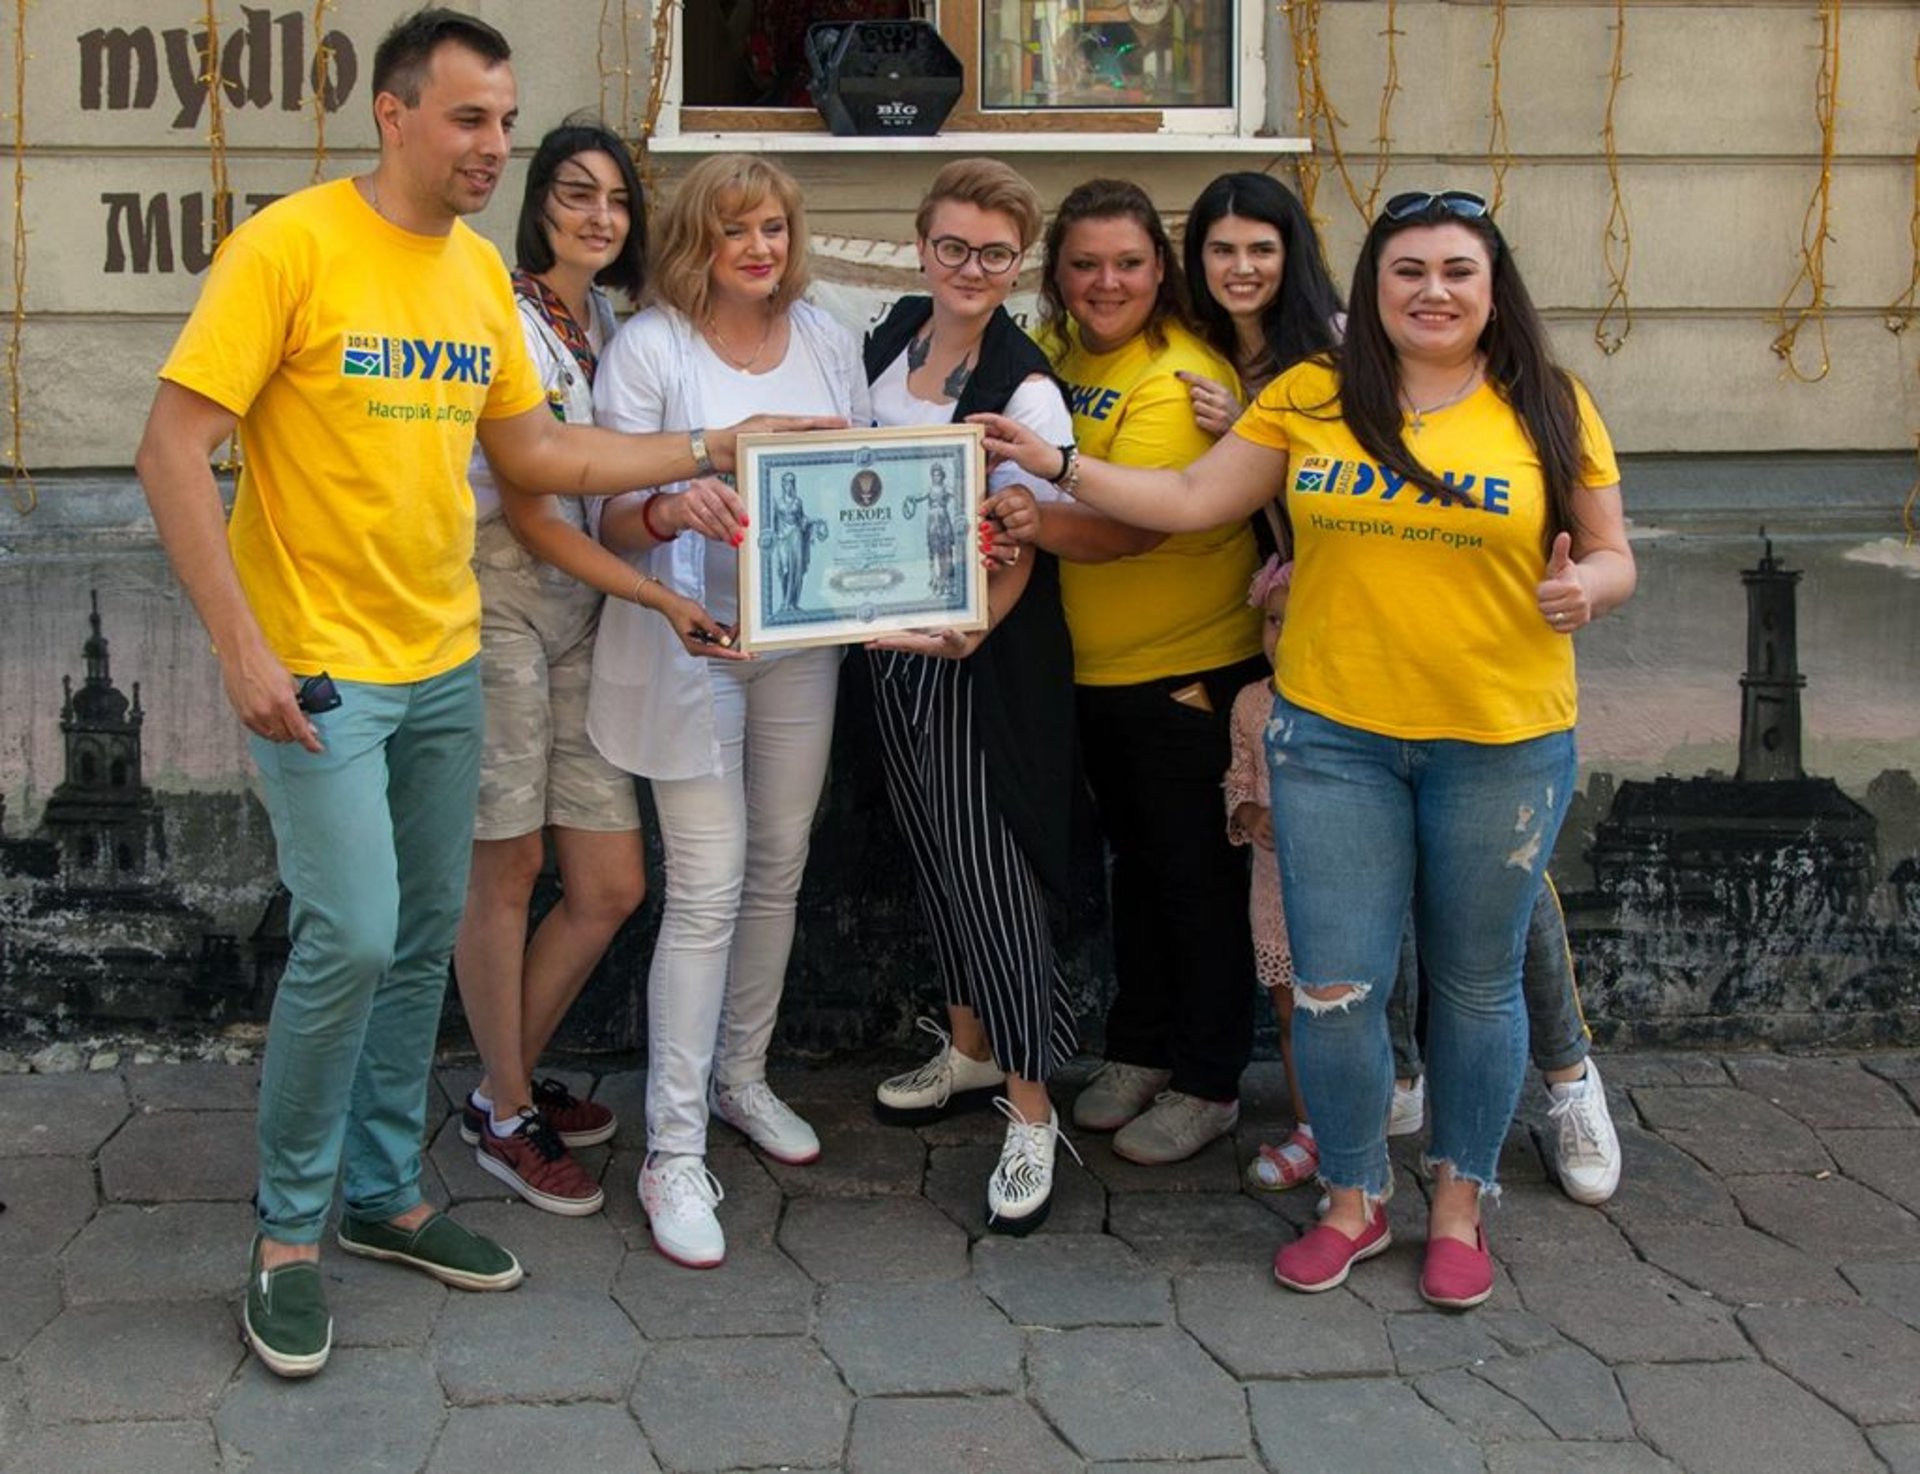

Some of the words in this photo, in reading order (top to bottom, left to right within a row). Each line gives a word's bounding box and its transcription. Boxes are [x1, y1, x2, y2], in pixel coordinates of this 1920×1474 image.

[77, 4, 357, 129] mydlo
[876, 104, 919, 115] BIG
[367, 400, 431, 424] Настрій
[1311, 514, 1395, 536] Настрій
